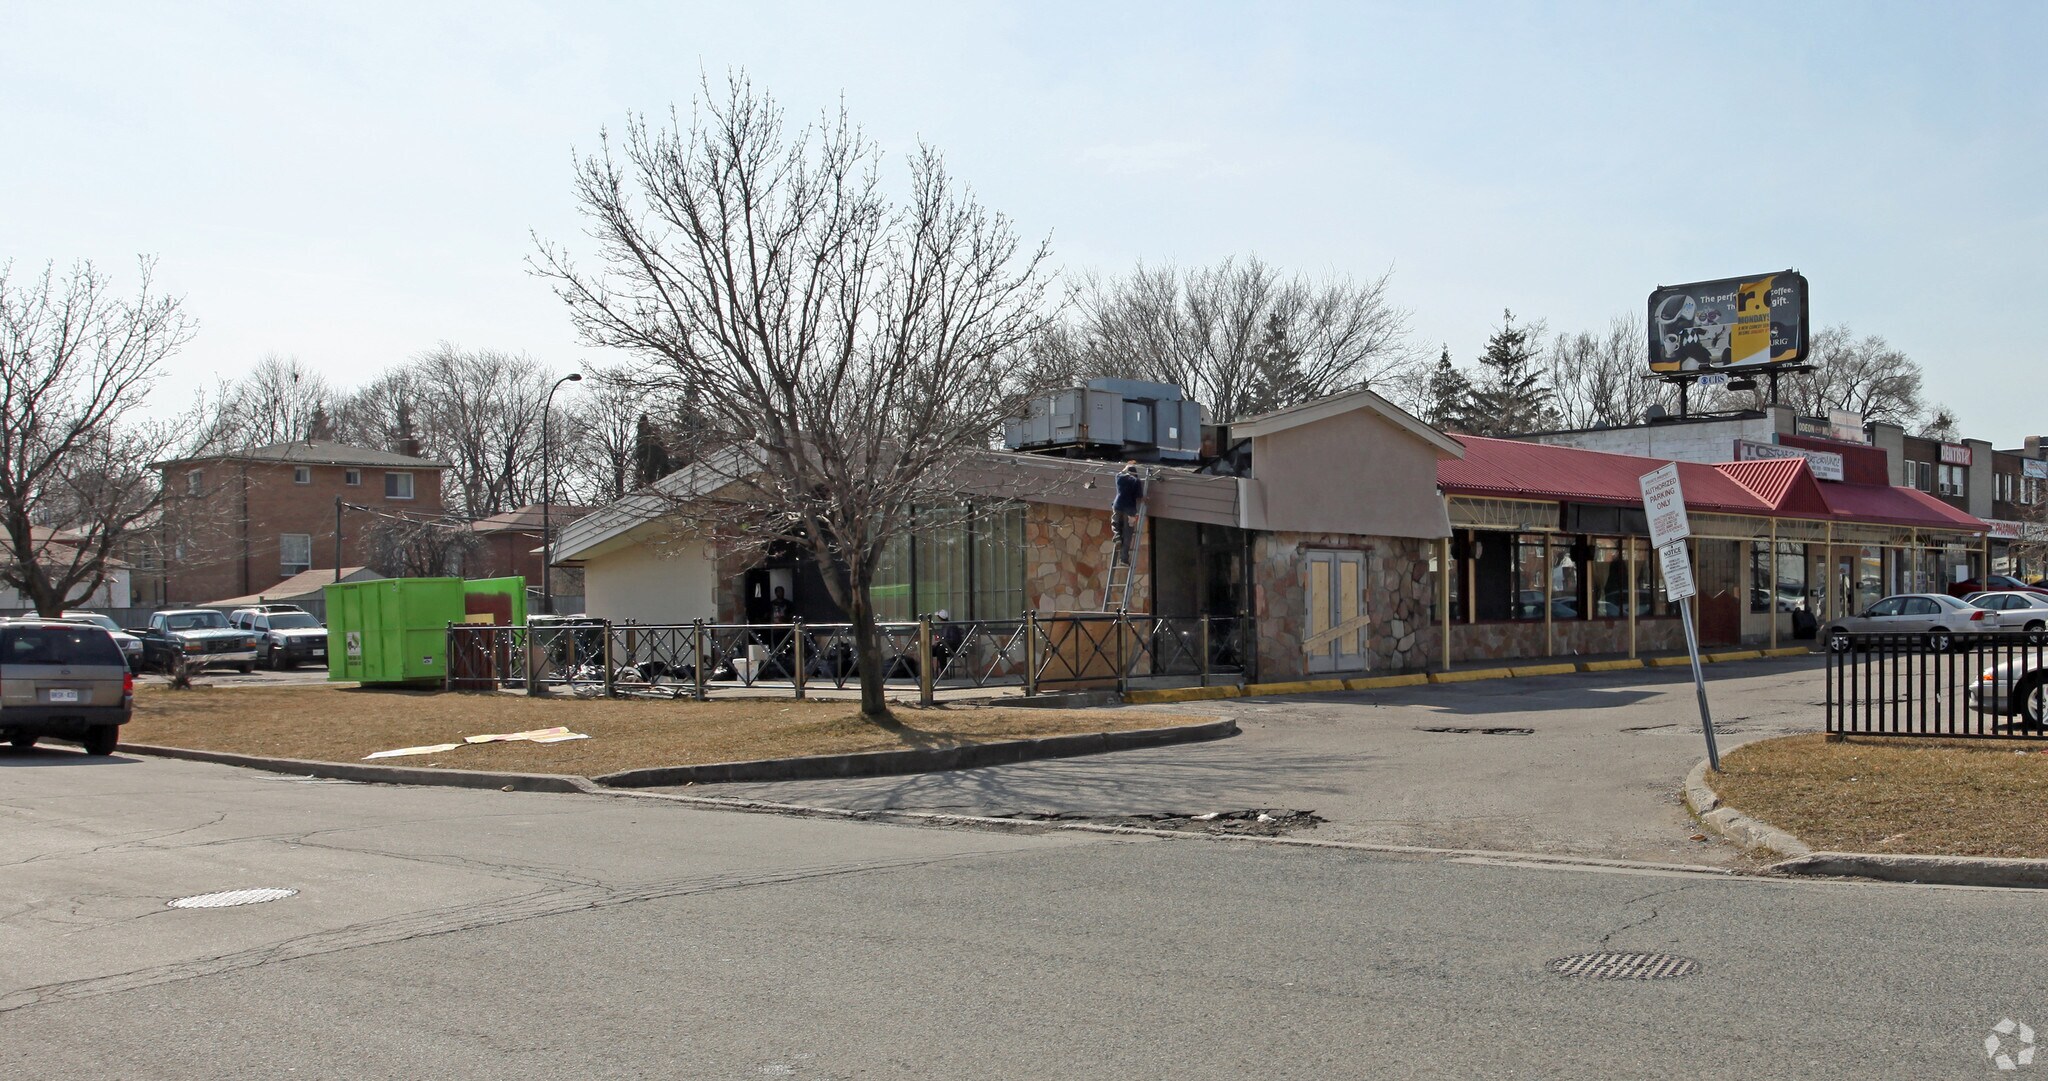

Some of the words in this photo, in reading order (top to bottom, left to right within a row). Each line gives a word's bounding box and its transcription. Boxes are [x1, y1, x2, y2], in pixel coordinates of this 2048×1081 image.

[1771, 297, 1790, 307] gift.
[1708, 375, 1725, 384] CBS
[1798, 422, 1815, 433] ODEON
[1645, 477, 1677, 496] AUTHORIZED
[1649, 487, 1675, 504] PARKING
[1656, 498, 1671, 510] ONLY
[1663, 546, 1682, 557] NOTICE
